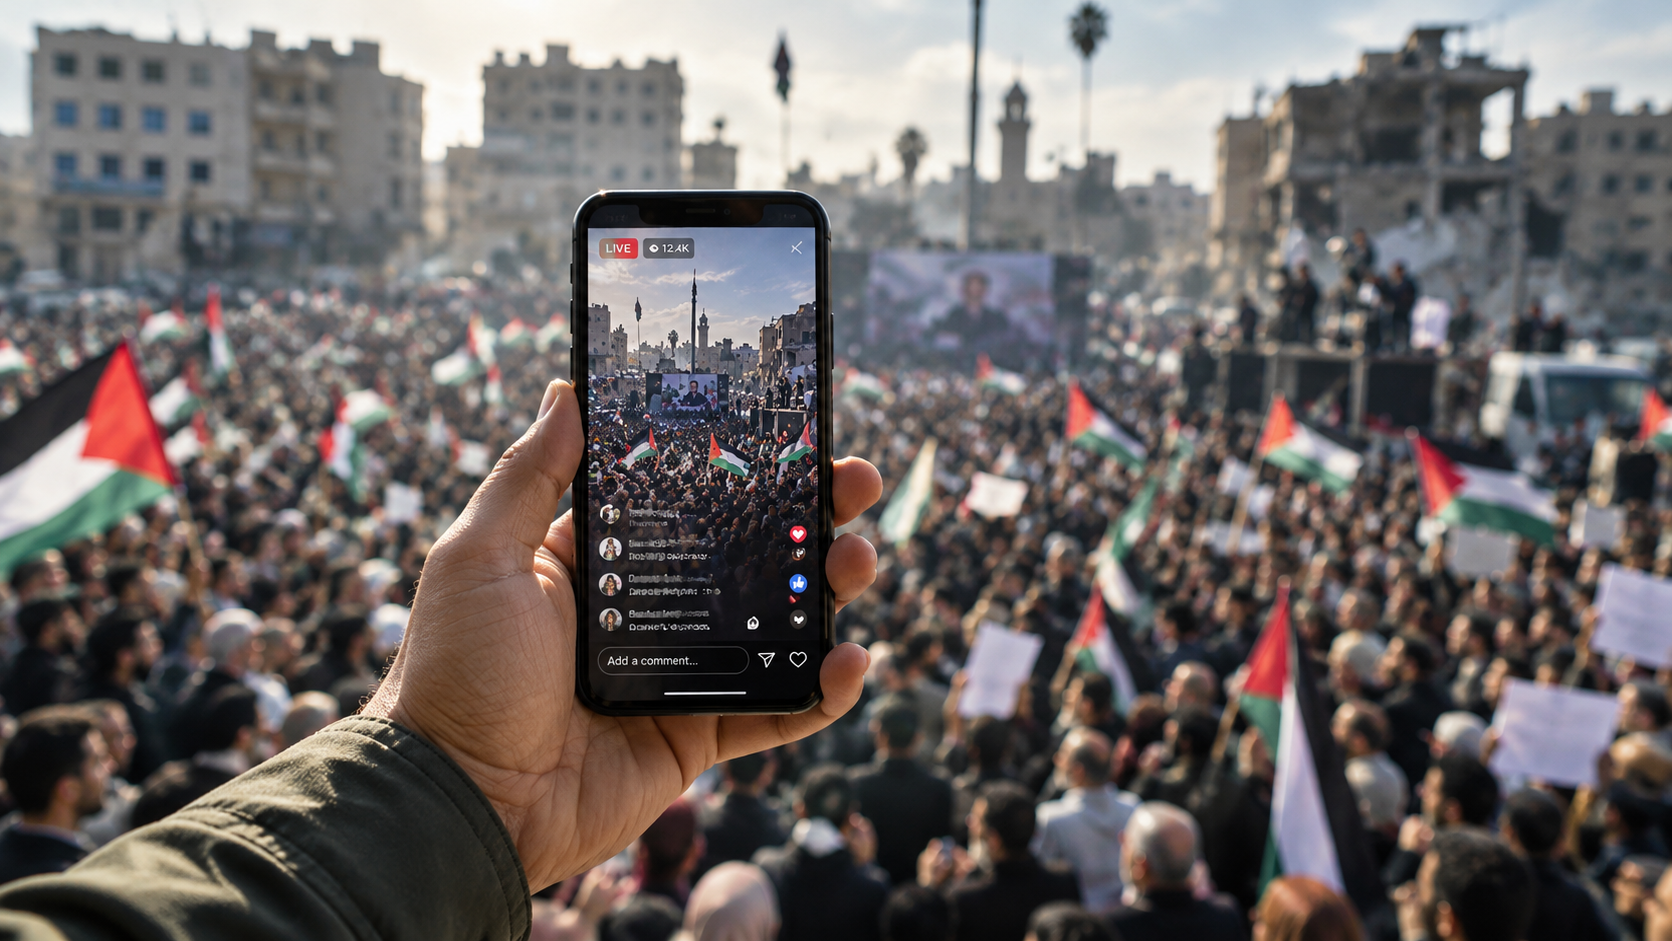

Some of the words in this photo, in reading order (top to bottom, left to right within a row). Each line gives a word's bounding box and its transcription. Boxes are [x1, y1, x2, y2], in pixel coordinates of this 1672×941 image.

[605, 243, 631, 254] LIVE
[607, 656, 629, 666] Add
[631, 658, 639, 666] a
[640, 656, 699, 666] comment...
